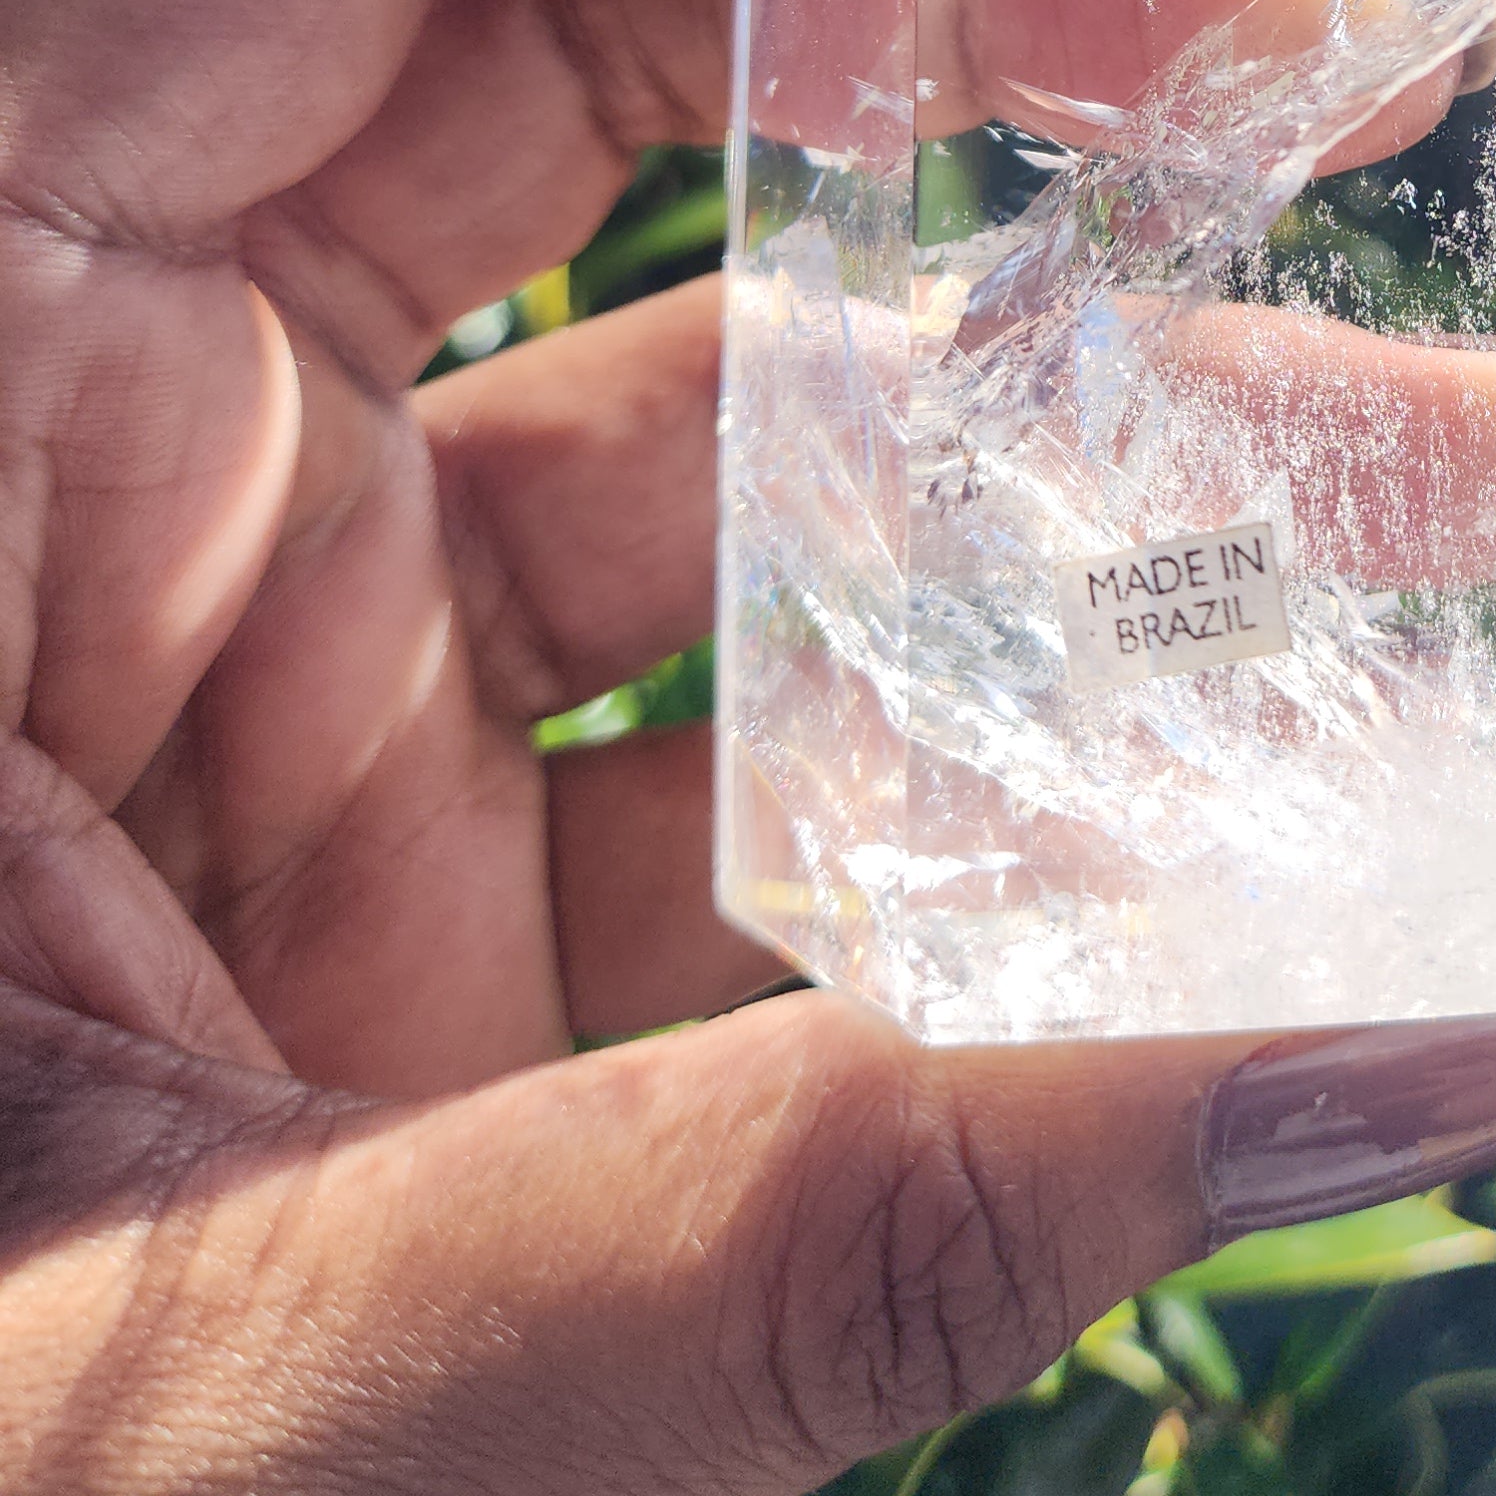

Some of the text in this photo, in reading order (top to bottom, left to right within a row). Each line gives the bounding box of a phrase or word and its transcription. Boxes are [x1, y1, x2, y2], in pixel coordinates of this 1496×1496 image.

[1087, 537, 1265, 608] MADE IN
[1115, 595, 1258, 654] BRAZIL
